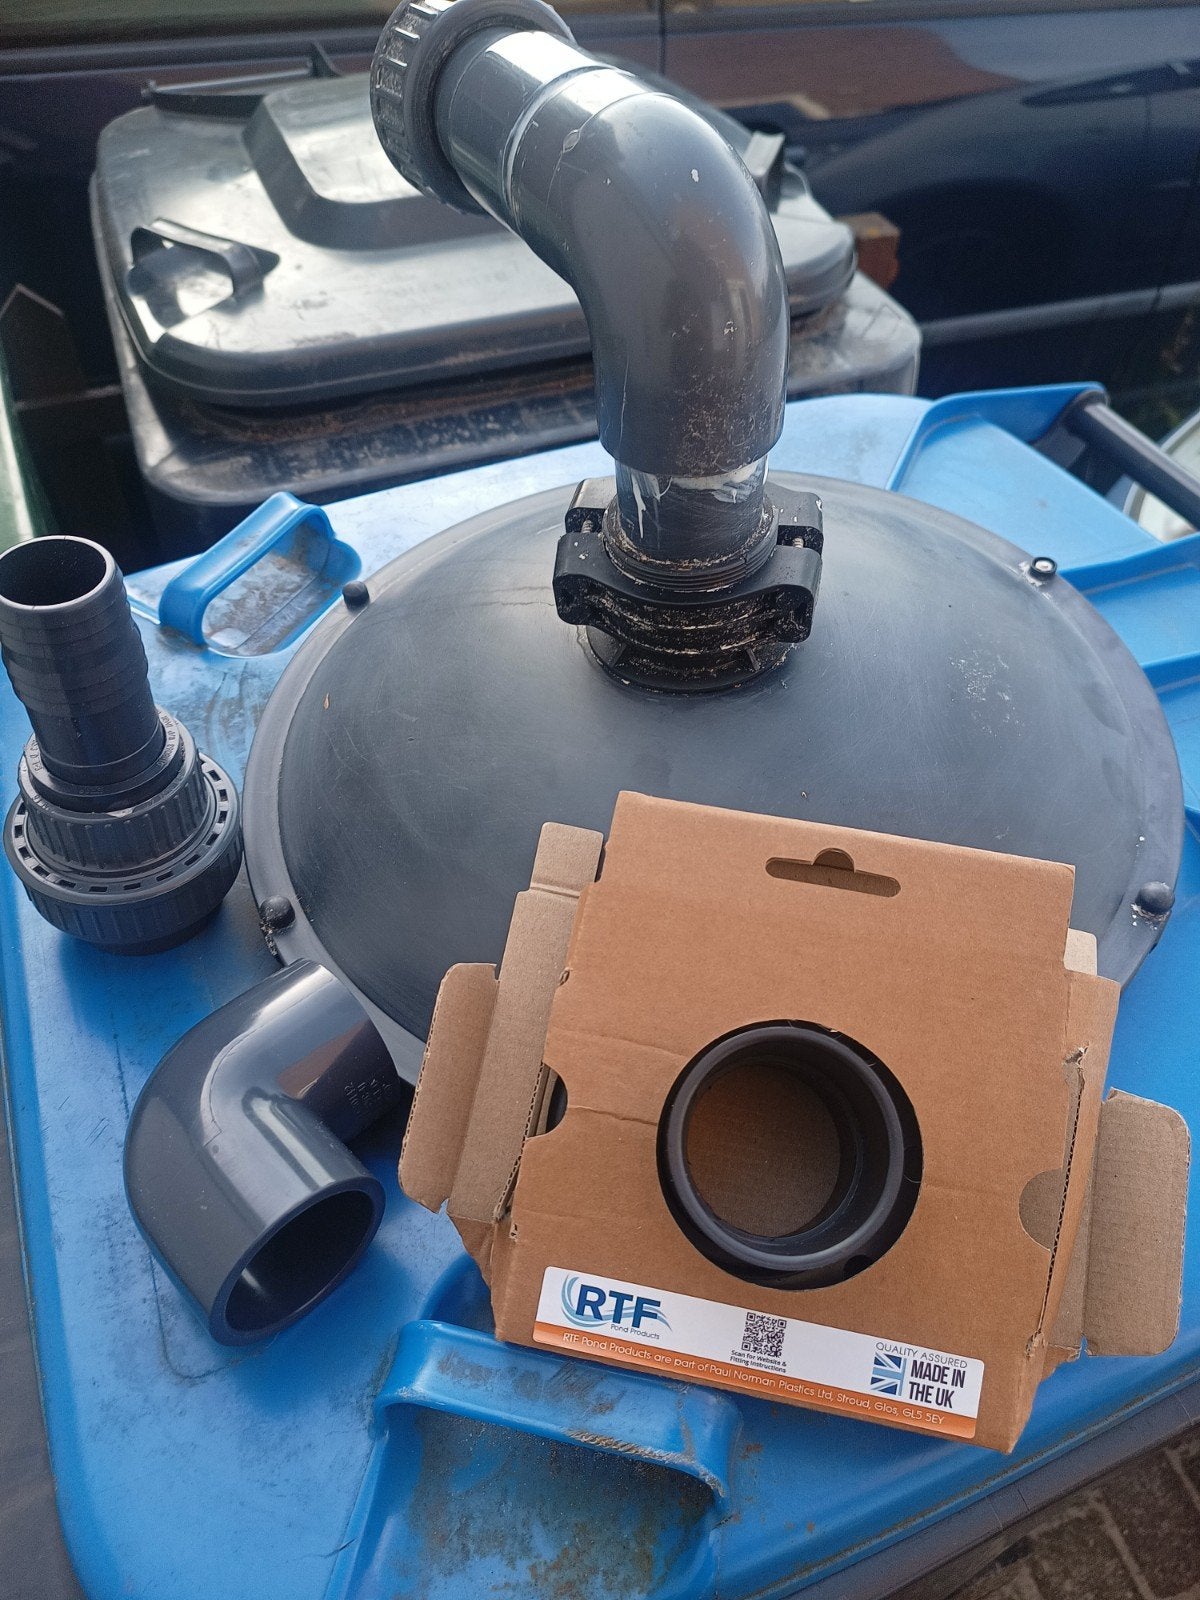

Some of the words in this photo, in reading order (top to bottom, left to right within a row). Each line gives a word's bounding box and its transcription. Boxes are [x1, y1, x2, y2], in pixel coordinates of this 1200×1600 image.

[576, 1284, 661, 1328] RTF
[611, 1324, 629, 1333] Pond
[630, 1328, 660, 1339] Products
[730, 1356, 749, 1366] Fitting
[750, 1361, 786, 1373] Instructions
[731, 1350, 745, 1358] Scan
[757, 1356, 781, 1365] Website
[876, 1342, 918, 1357] QUALITY
[920, 1352, 968, 1369] ASSURED
[563, 1332, 579, 1343] RTF
[581, 1336, 608, 1350] Pond
[609, 1342, 651, 1360] Products
[654, 1354, 672, 1364] are
[674, 1358, 696, 1369] part
[697, 1363, 709, 1371] of
[709, 1364, 732, 1377] Paul
[733, 1370, 776, 1387] Norman
[778, 1379, 815, 1396] Plastics
[817, 1389, 833, 1402] Ltd,
[837, 1393, 871, 1410] Stroud,
[875, 1402, 899, 1417] Glos,
[902, 1408, 923, 1420] GL5
[925, 1413, 945, 1425] 5EY
[910, 1360, 950, 1385] MADE
[951, 1369, 966, 1388] IN
[909, 1381, 934, 1404] THE
[935, 1387, 955, 1409] UK
